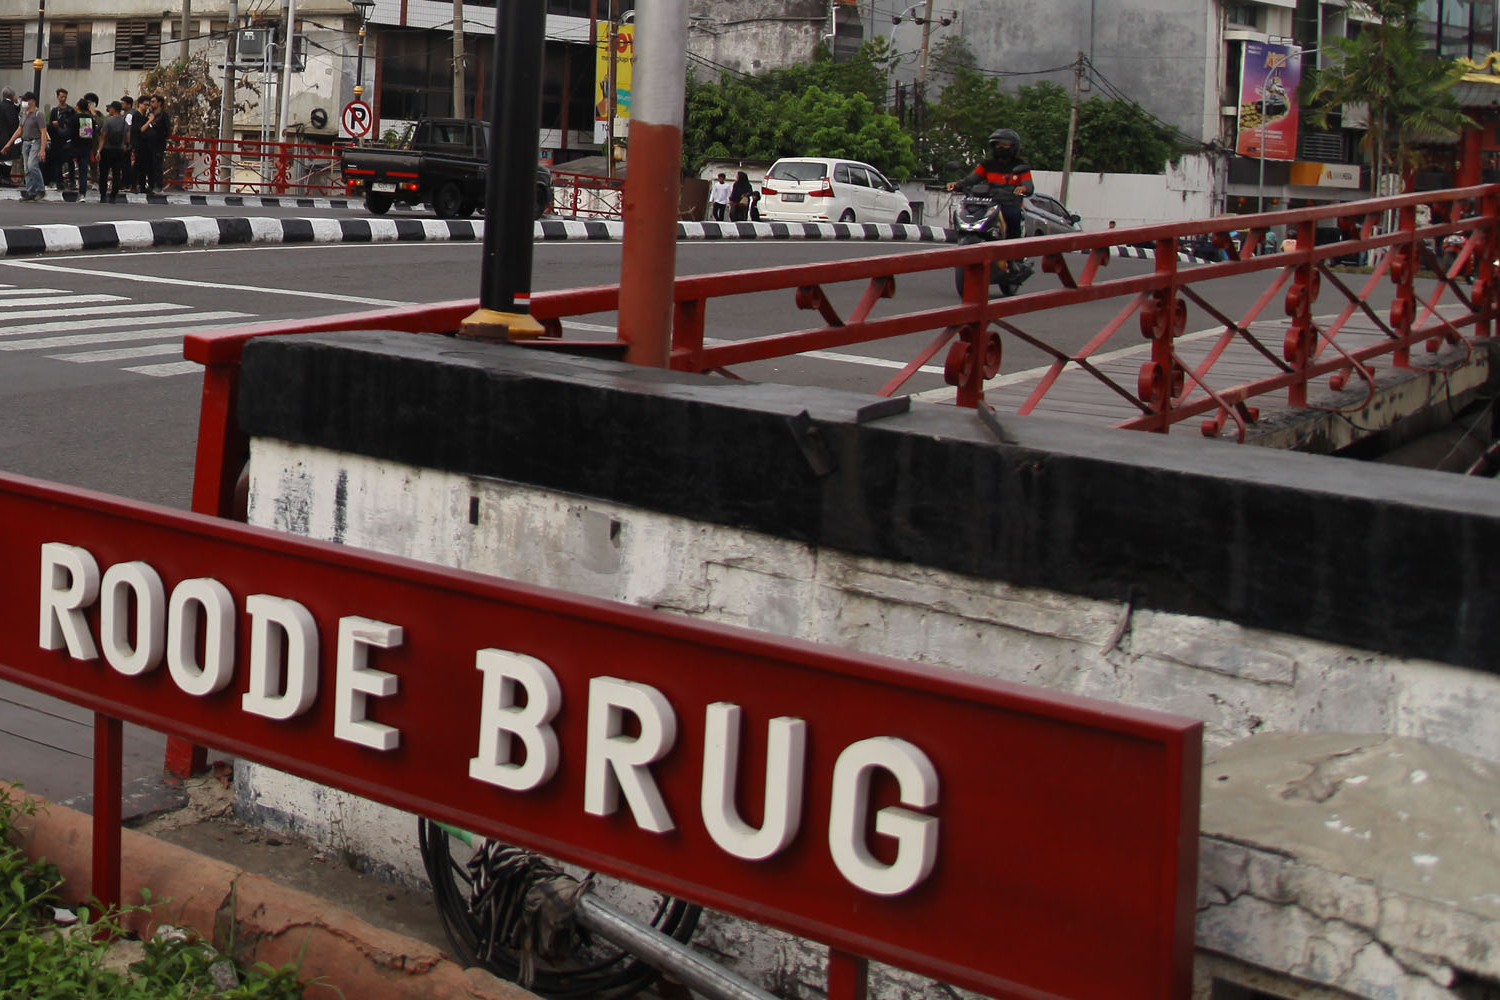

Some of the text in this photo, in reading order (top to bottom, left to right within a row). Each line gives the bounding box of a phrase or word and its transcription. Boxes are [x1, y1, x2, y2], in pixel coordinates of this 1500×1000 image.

[350, 106, 366, 130] P
[39, 541, 940, 898] ROODE BRUG
